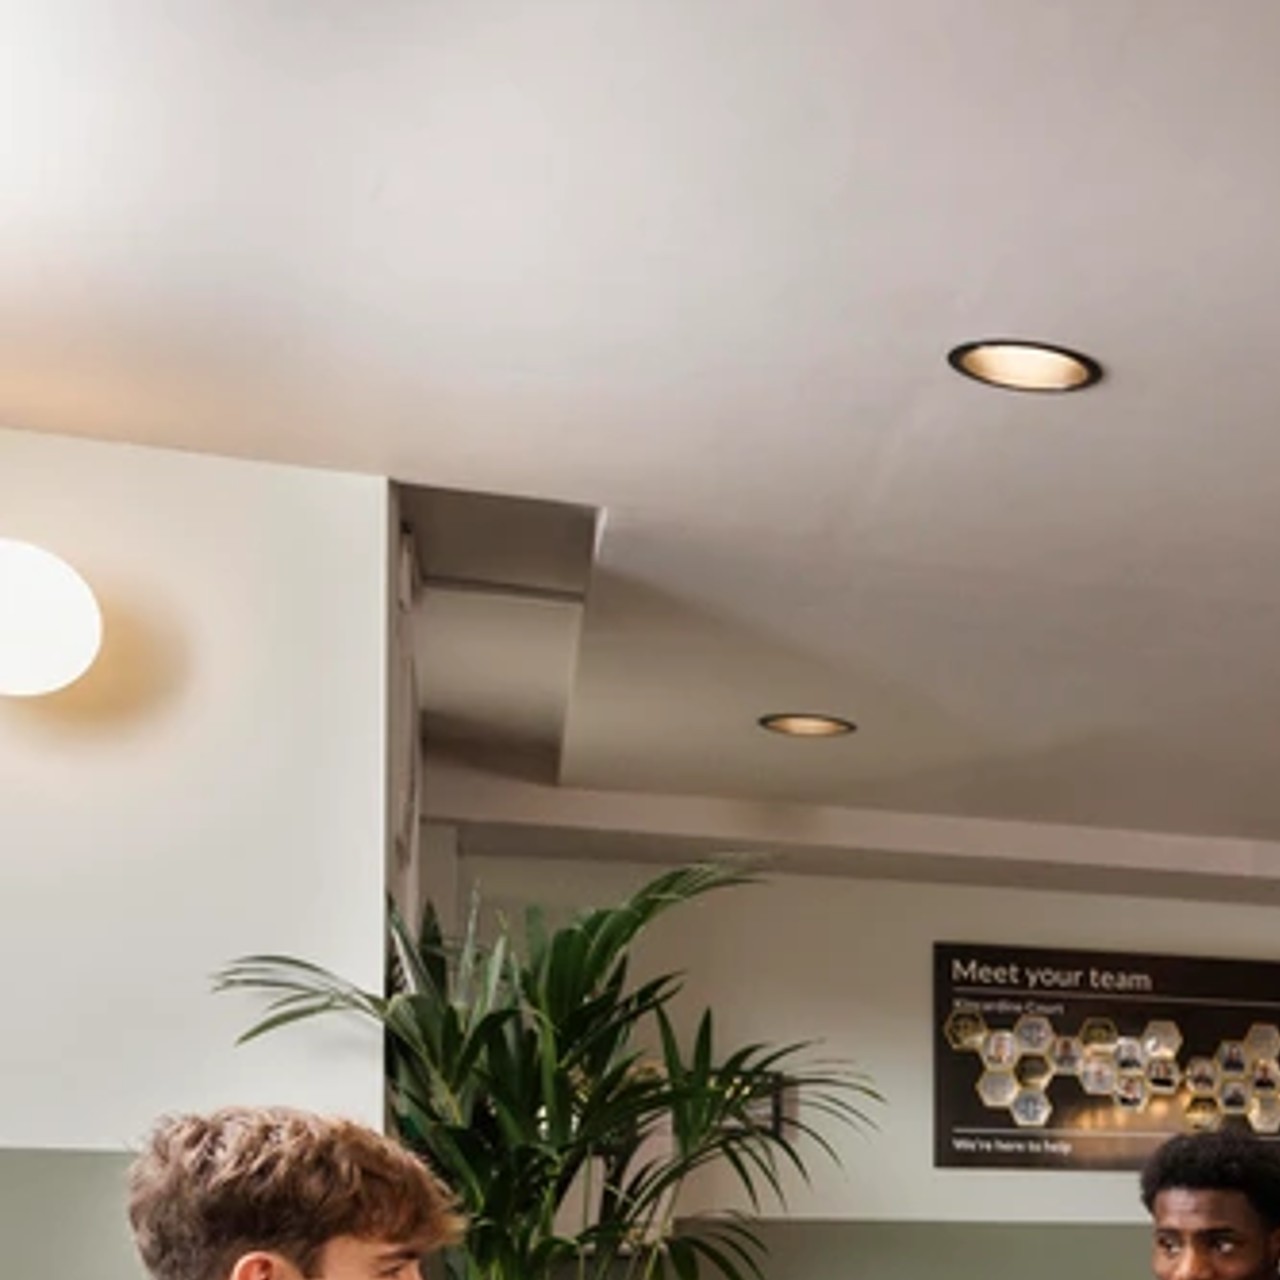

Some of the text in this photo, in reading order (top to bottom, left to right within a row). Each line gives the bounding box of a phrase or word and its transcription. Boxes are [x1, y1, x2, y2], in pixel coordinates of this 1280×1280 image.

[951, 958, 1154, 991] Meet your team
